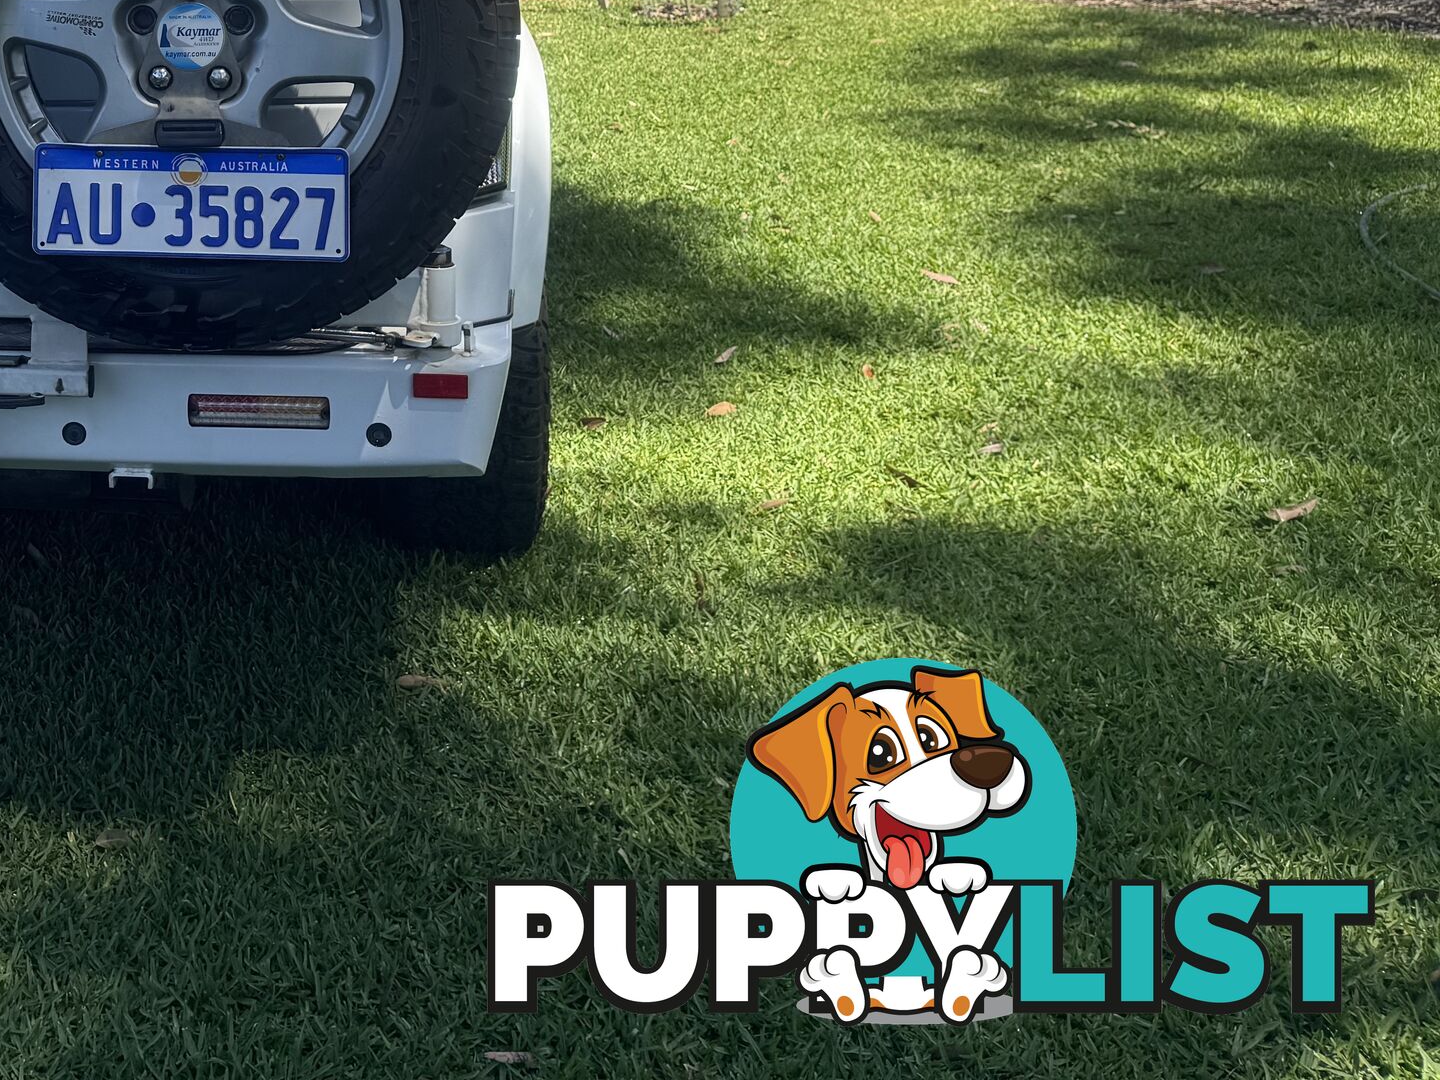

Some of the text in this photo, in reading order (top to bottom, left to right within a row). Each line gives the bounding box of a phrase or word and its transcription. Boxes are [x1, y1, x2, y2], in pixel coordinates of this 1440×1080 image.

[46, 13, 104, 29] COMPOMOTIVE
[176, 26, 221, 40] Kaymar
[165, 50, 217, 59] kaymar.com.au
[92, 158, 289, 172] WESTERN AUSTRALIA
[46, 182, 122, 245] AU
[163, 184, 336, 251] 35827
